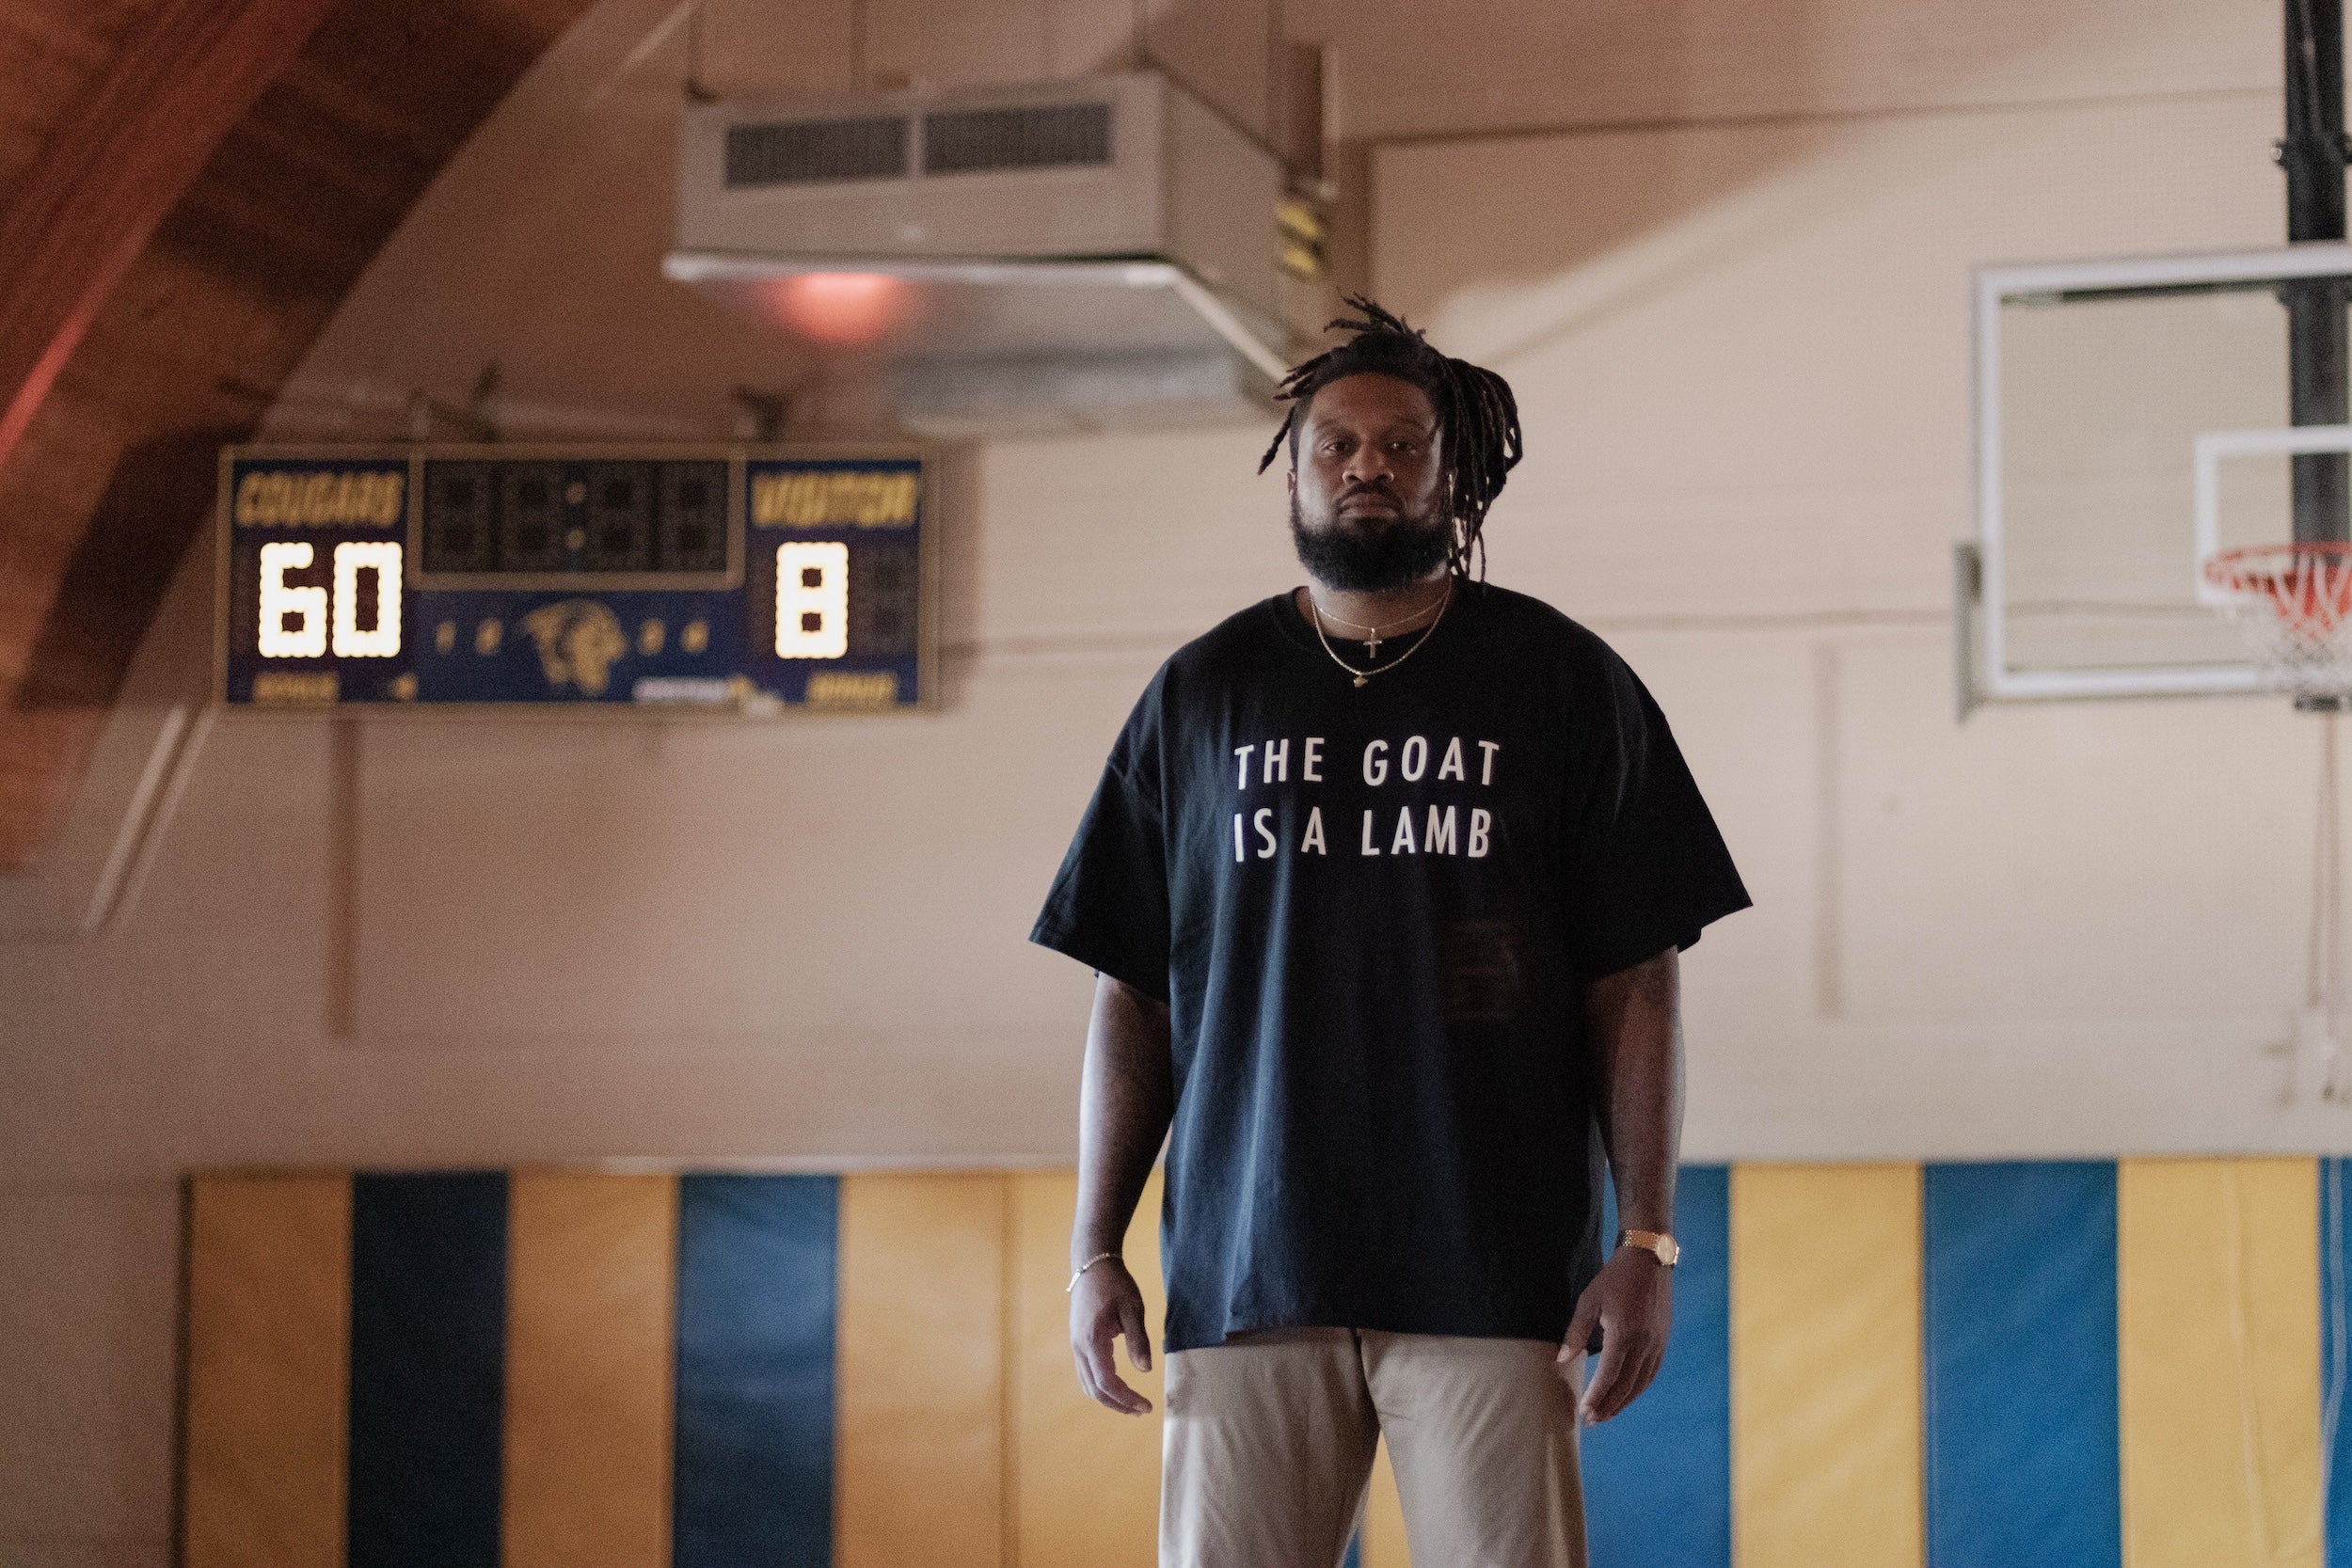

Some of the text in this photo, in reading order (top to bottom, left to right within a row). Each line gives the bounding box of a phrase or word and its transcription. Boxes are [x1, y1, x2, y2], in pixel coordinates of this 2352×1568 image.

[258, 542, 403, 658] 60
[775, 542, 849, 659] 8
[1233, 735, 1500, 791] THE GOAT
[1233, 804, 1491, 863] IS A LAMB
